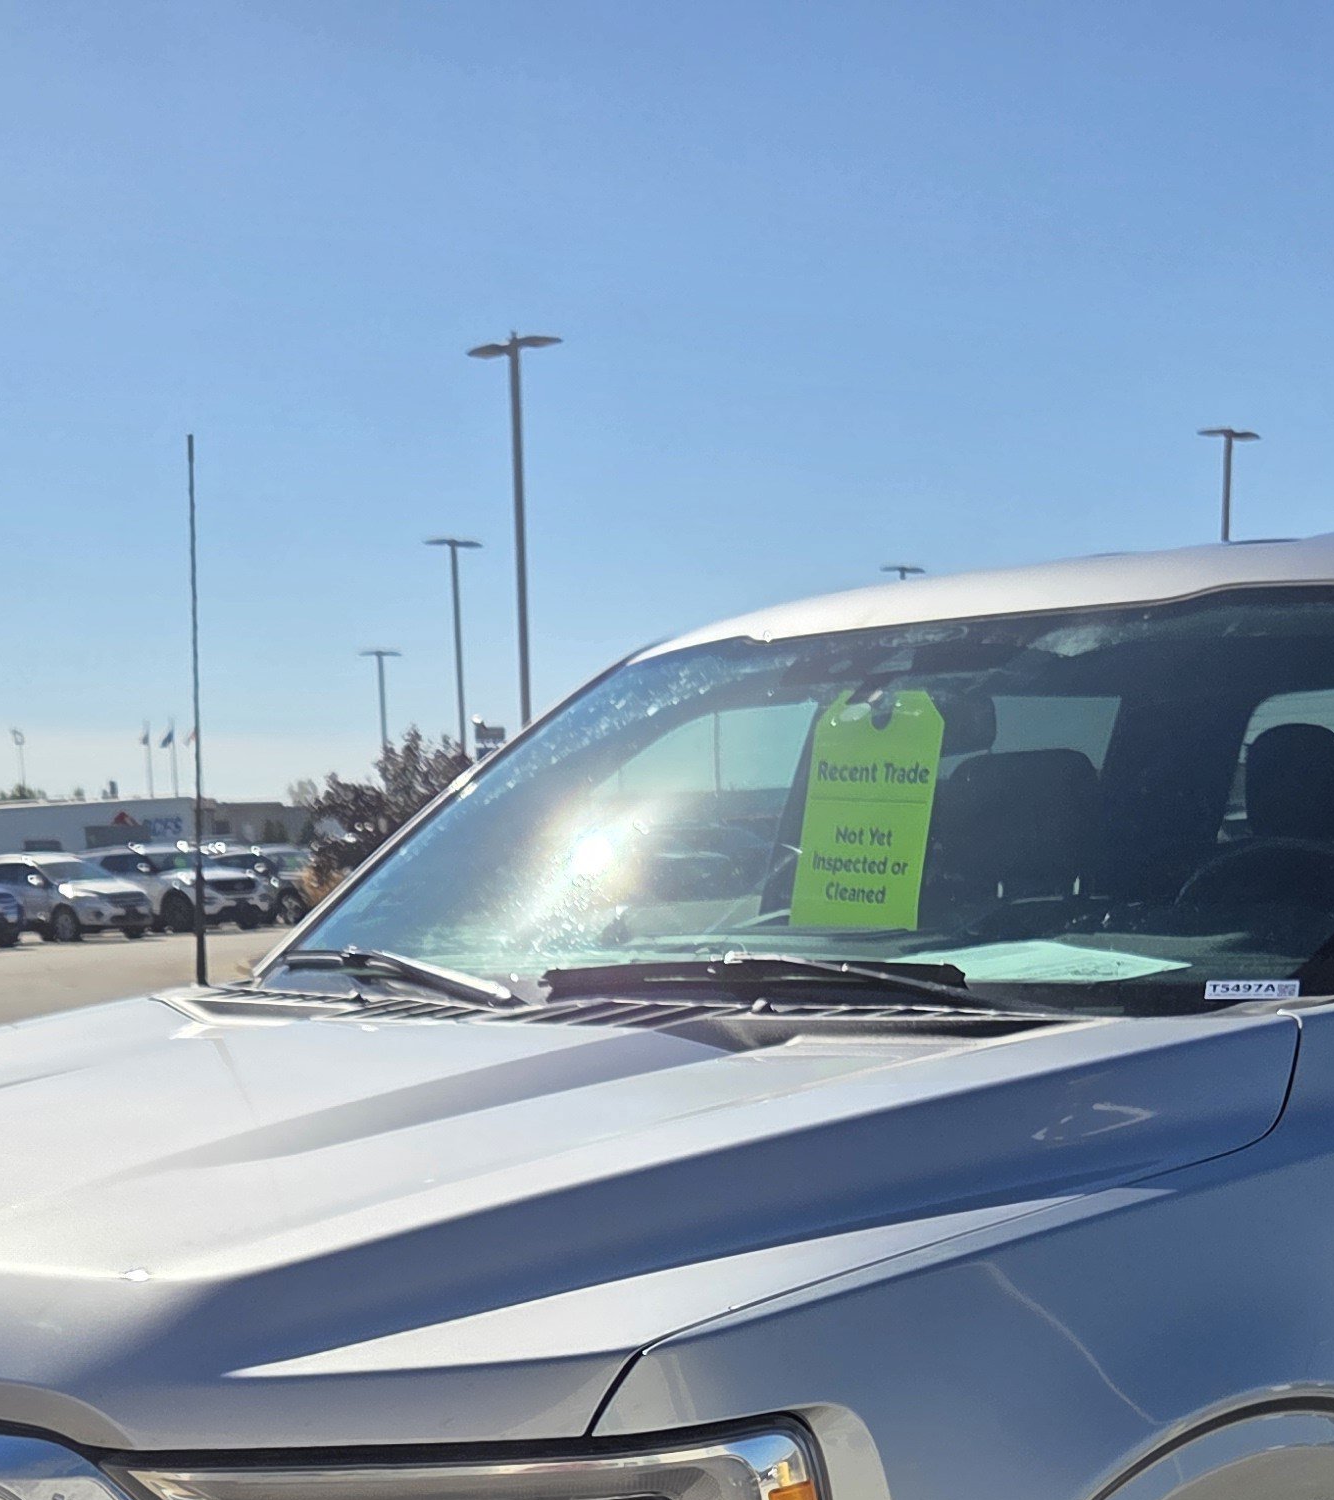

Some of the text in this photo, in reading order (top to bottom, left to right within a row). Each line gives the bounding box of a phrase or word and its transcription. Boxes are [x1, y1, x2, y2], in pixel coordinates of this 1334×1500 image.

[818, 761, 930, 784] Recent Trade
[835, 826, 893, 847] Not Yet
[813, 851, 908, 875] Inspected or
[825, 882, 886, 904] Cleaned
[1209, 983, 1276, 994] T5497A
